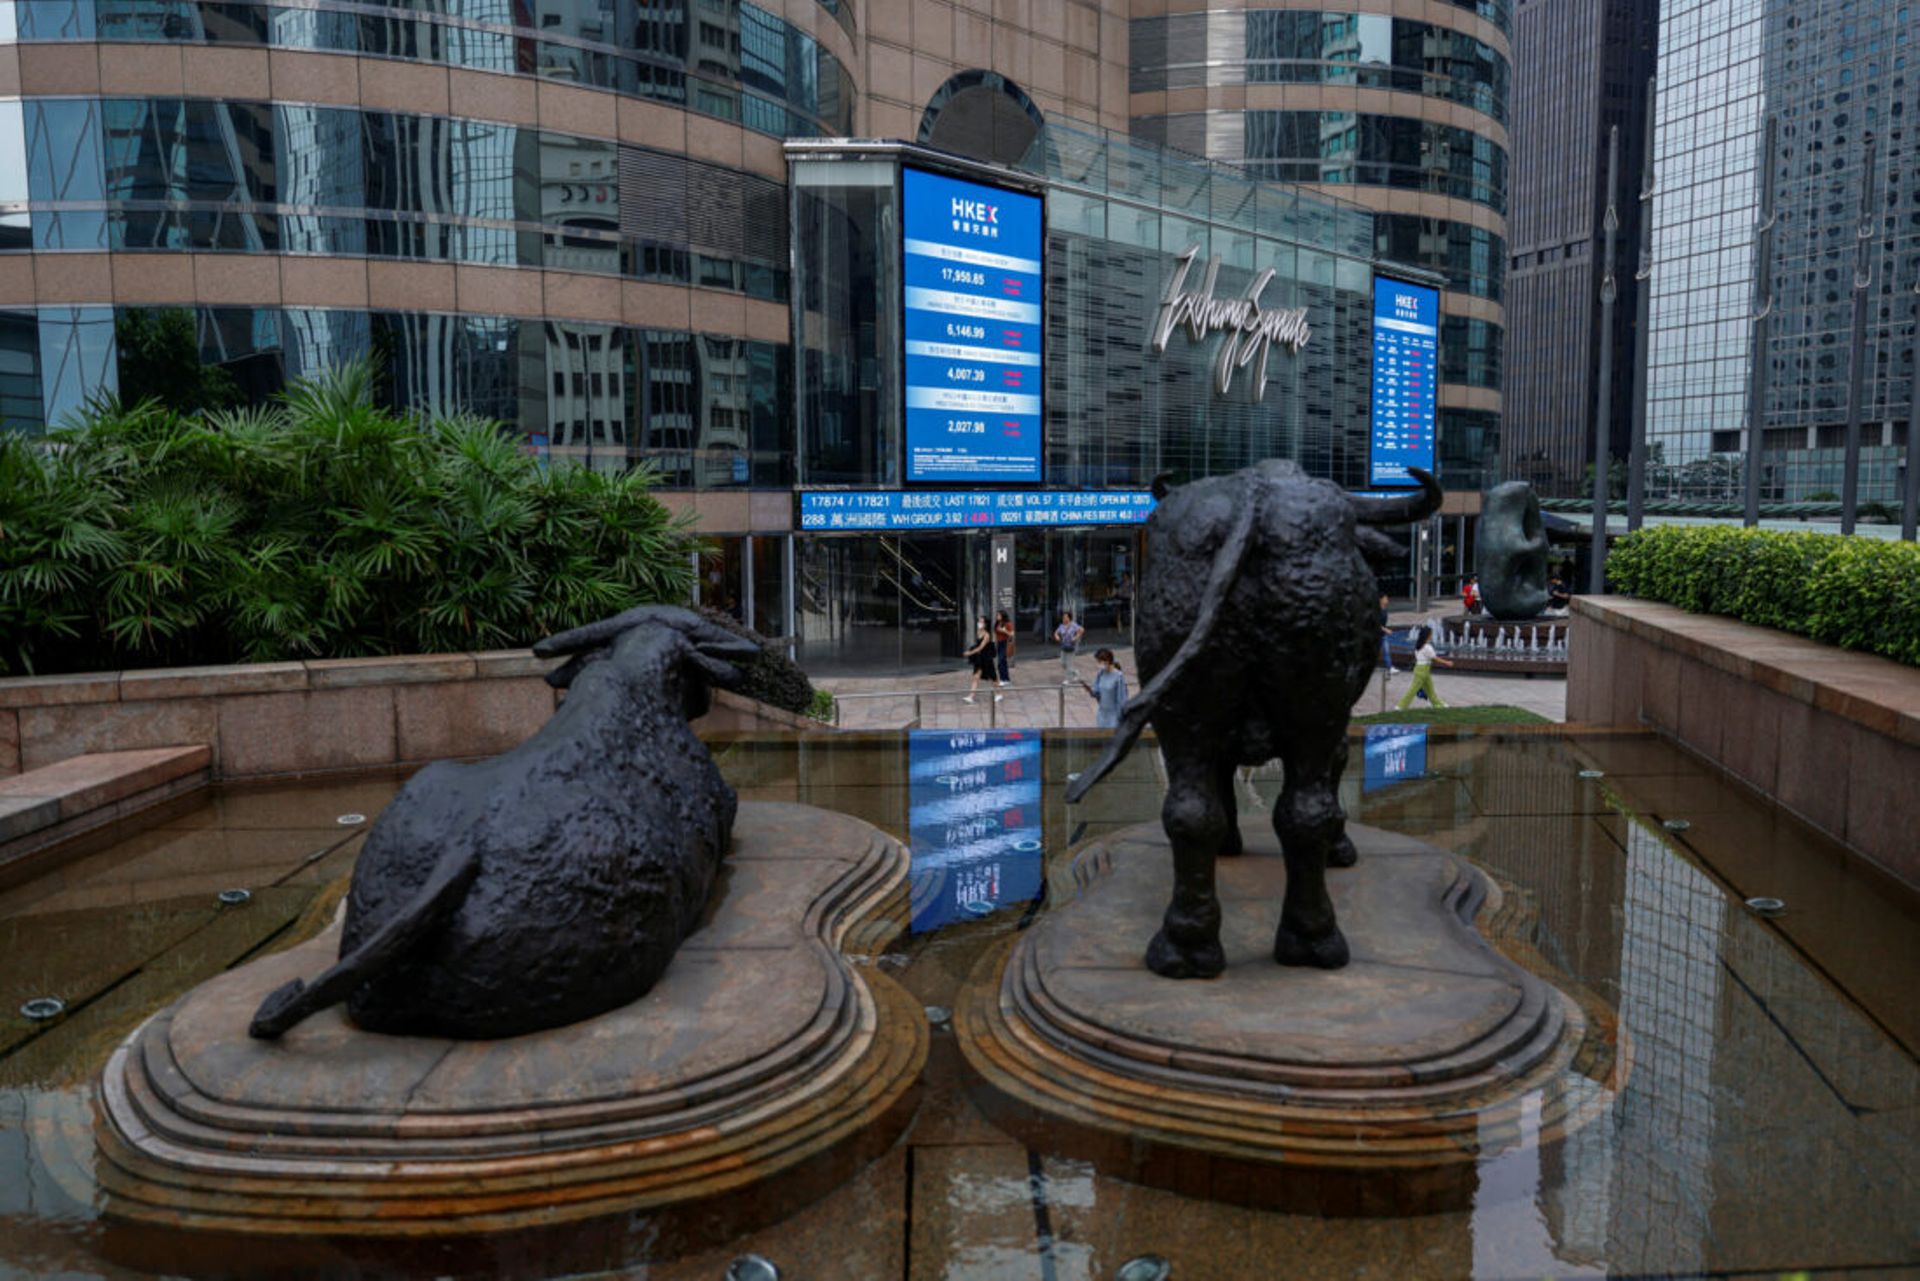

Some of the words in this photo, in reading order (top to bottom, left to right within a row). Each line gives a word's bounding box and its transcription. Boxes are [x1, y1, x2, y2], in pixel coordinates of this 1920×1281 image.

[952, 198, 998, 224] HKEX
[812, 495, 845, 508] 17874
[857, 495, 889, 507] 17821
[944, 495, 965, 506] LAST
[911, 512, 943, 524] GROUP
